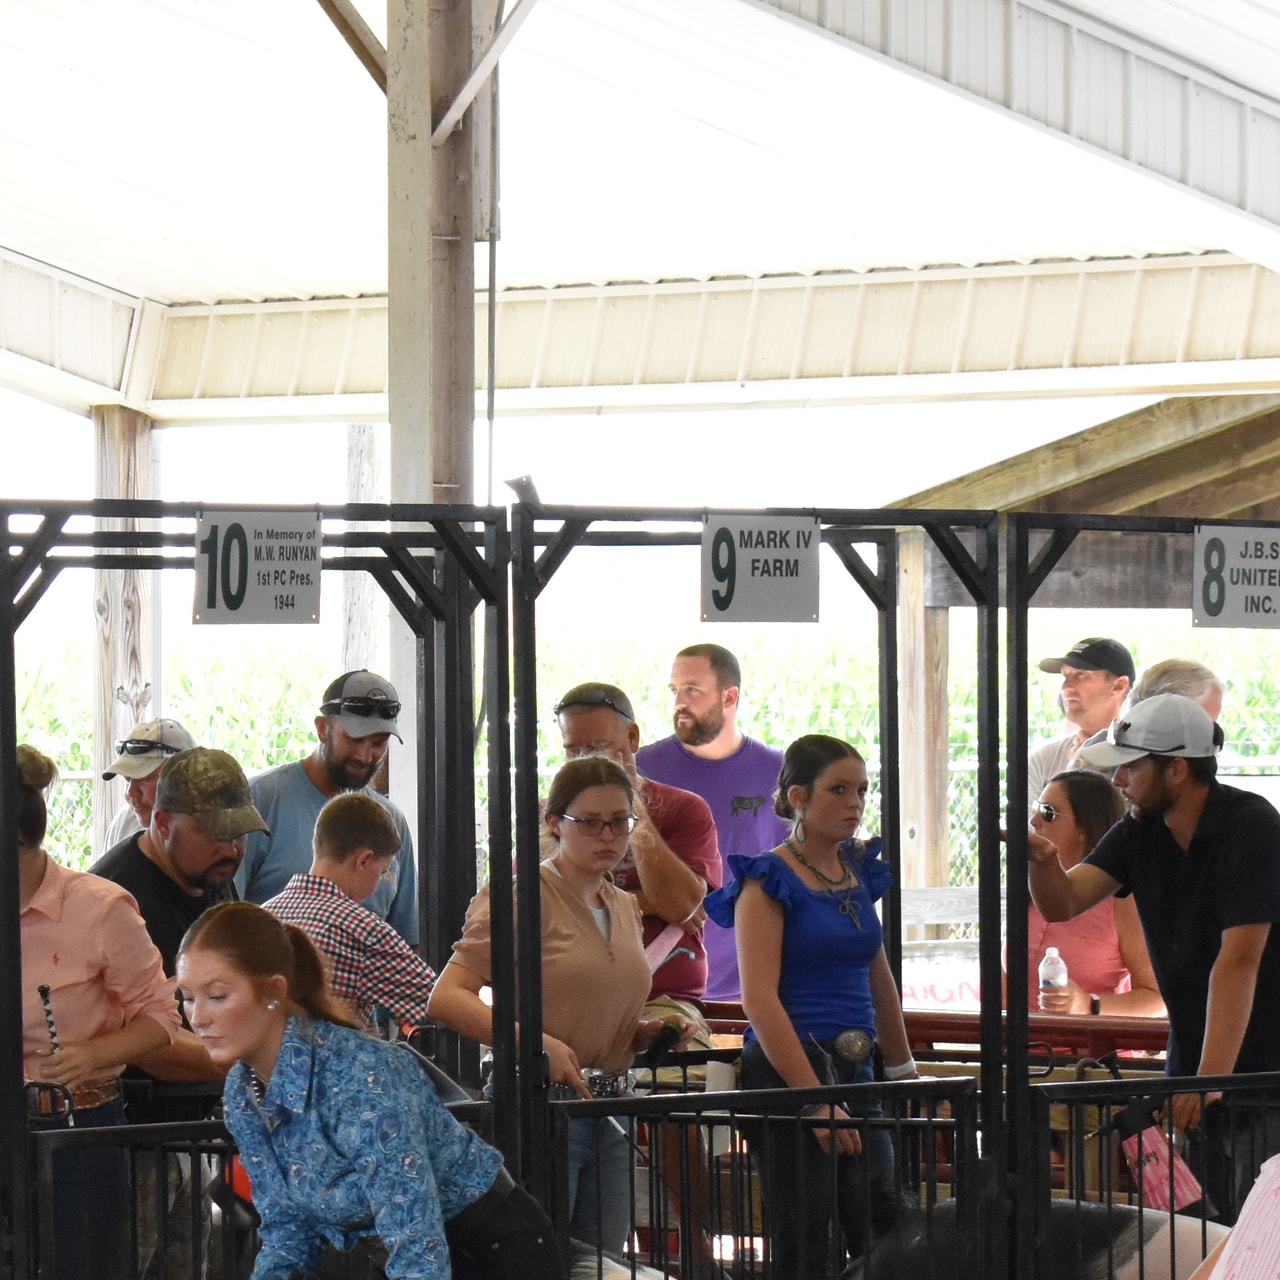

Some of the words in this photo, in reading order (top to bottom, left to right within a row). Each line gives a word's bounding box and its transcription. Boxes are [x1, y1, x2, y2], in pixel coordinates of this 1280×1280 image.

[253, 529, 263, 540] In
[267, 529, 303, 542] Memory
[306, 529, 316, 540] of
[738, 530, 791, 549] MARK
[795, 530, 813, 549] IV
[253, 545, 275, 561] M.W.
[278, 545, 317, 561] RUNYAN
[200, 522, 249, 611] 10
[711, 526, 737, 612] 9
[750, 558, 800, 577] FARM
[256, 570, 271, 586] 1st
[273, 570, 287, 586] PC
[289, 570, 314, 586] Pres.
[1202, 536, 1226, 618] 8
[274, 595, 296, 610] 1944
[1244, 595, 1277, 614] INC.
